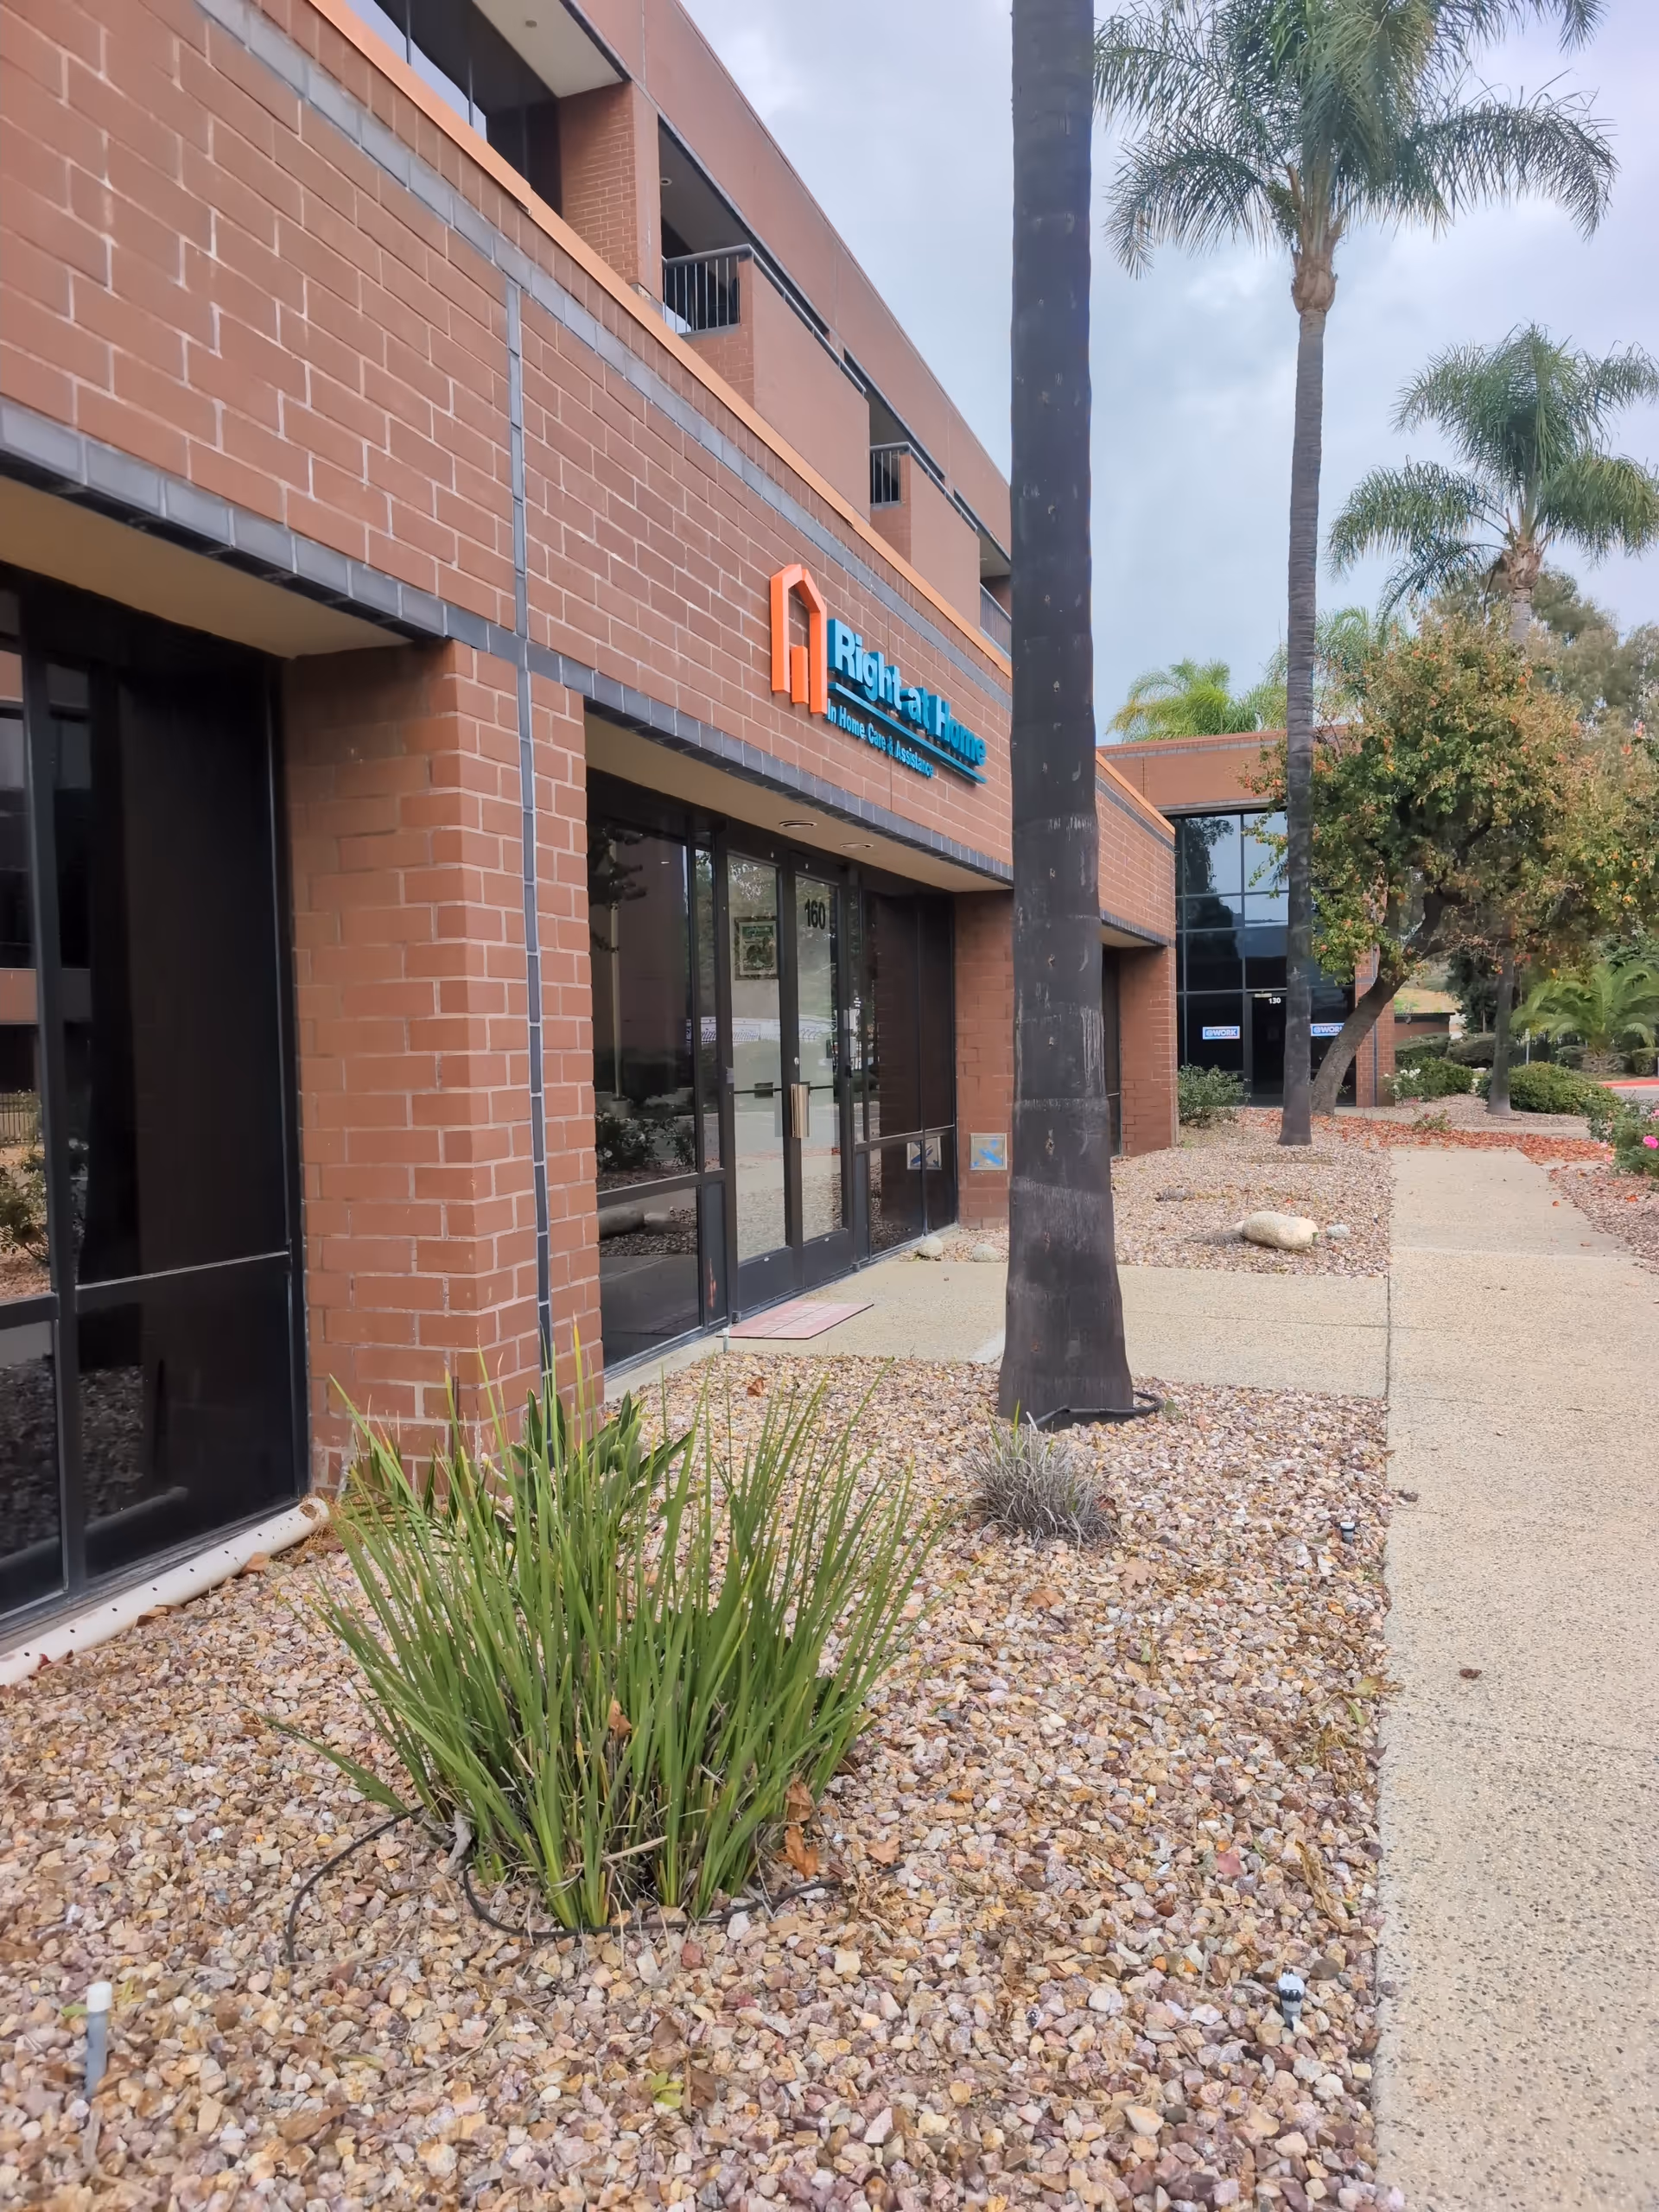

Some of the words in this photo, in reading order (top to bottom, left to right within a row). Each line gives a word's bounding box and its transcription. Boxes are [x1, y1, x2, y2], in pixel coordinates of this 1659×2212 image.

[828, 619, 902, 710] Right
[901, 687, 930, 729] at
[931, 695, 987, 767] Home
[827, 698, 837, 724] In
[838, 705, 866, 740] Home
[868, 722, 887, 752] Care
[887, 735, 894, 757] &
[894, 741, 935, 779] Assistance
[804, 899, 826, 930] 160
